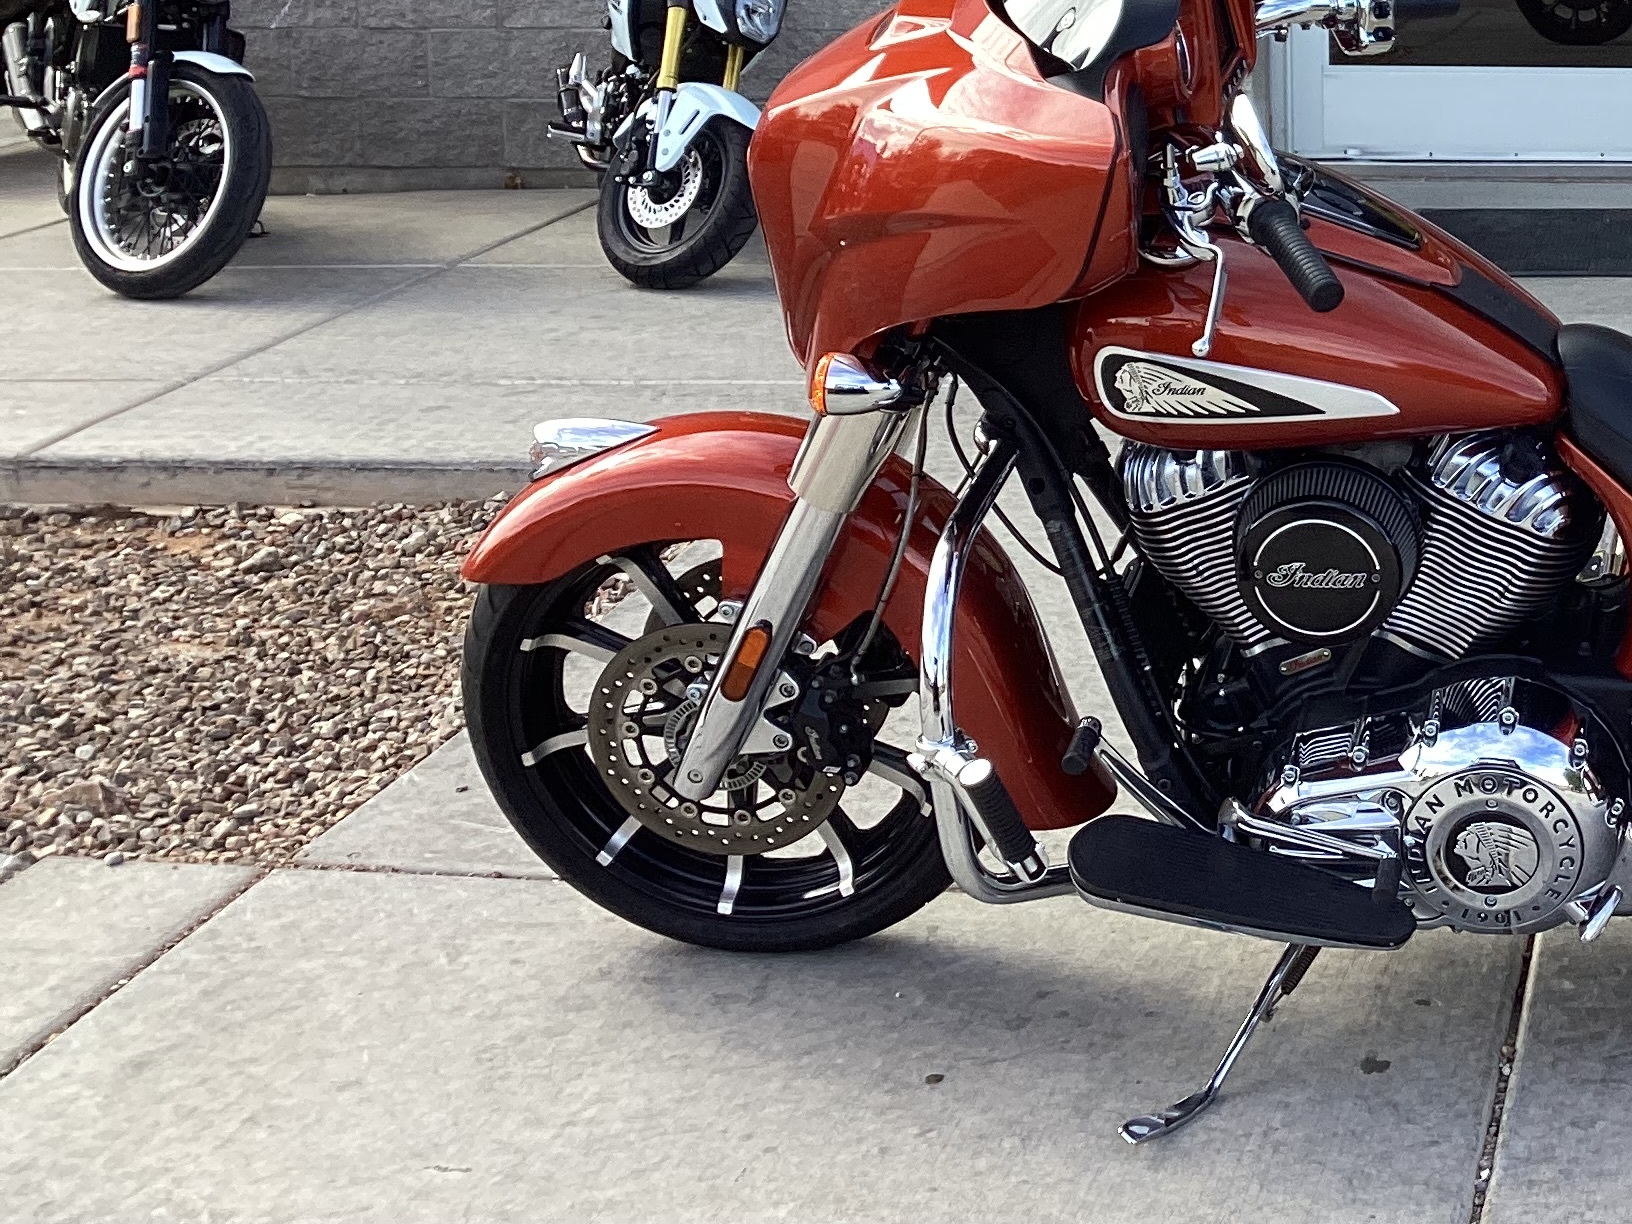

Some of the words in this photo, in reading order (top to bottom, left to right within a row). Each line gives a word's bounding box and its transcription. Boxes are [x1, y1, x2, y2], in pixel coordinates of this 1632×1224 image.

[1151, 381, 1206, 397] Indian
[1266, 562, 1367, 589] Indian
[1453, 776, 1576, 901] MOTORCYCLE
